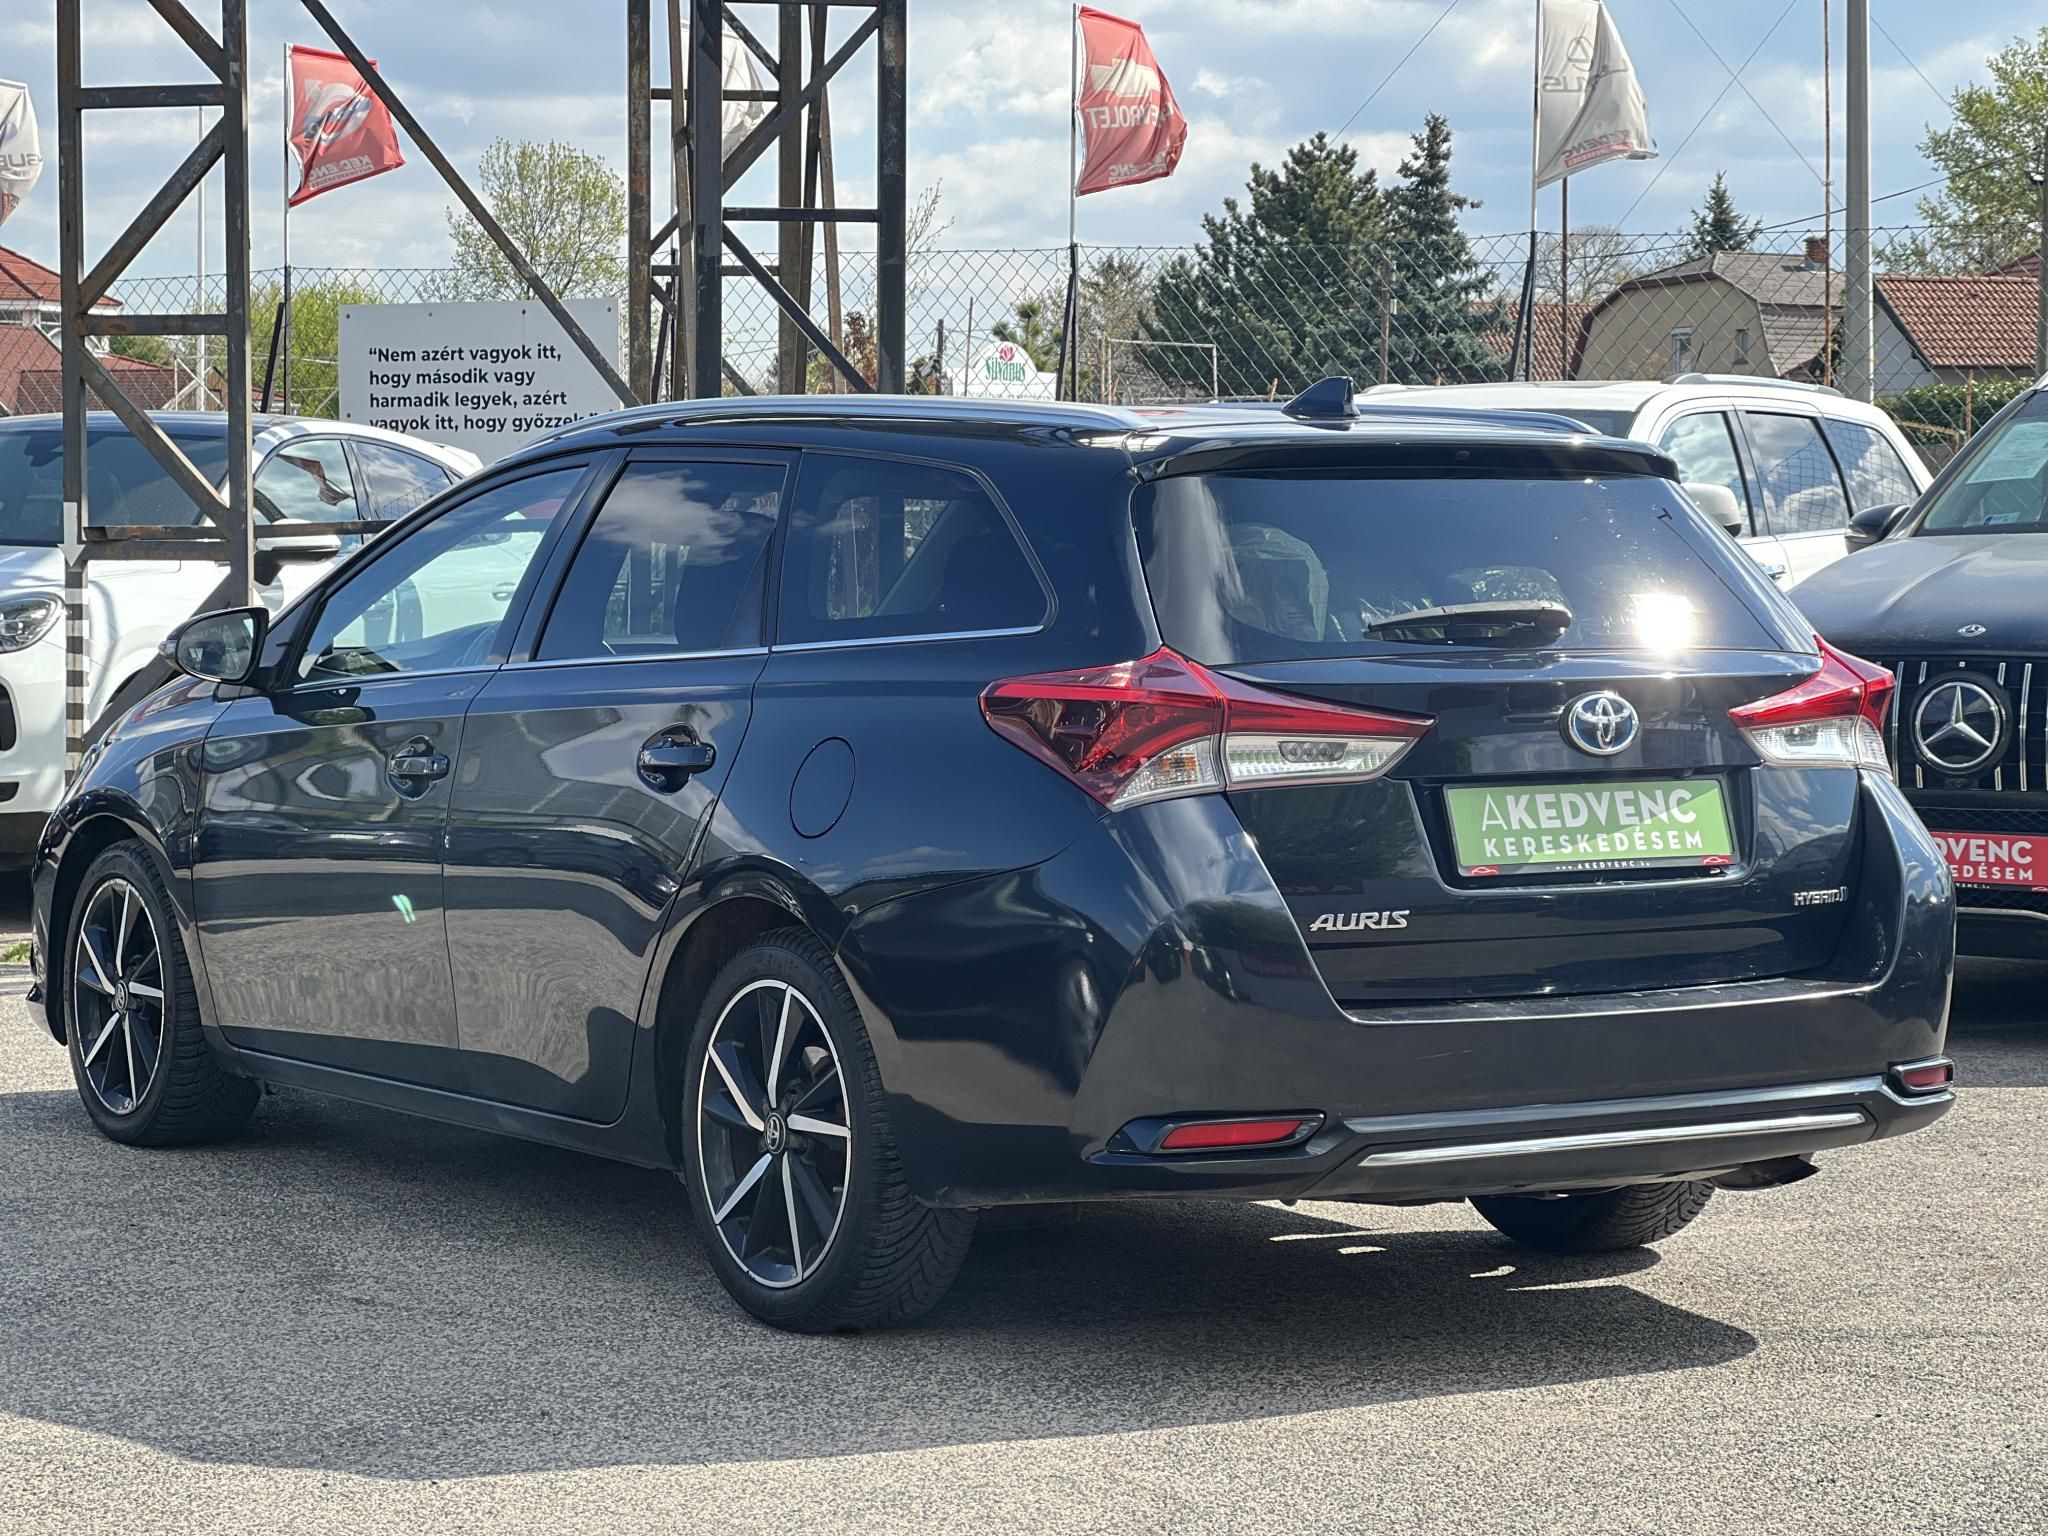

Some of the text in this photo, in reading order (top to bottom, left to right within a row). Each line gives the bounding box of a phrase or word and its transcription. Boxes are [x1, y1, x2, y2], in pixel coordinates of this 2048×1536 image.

[421, 346, 465, 361] azért
[469, 344, 532, 364] vagyok
[537, 343, 562, 362] itt,
[369, 368, 535, 388] hogy második vagy
[369, 390, 567, 410] harmadik legyek, azért
[369, 415, 430, 434] vagyok
[435, 414, 459, 432] itt,
[463, 414, 507, 433] hogy
[1483, 826, 1703, 858] KERESKEDÉSEM
[1309, 909, 1410, 932] AURIS
